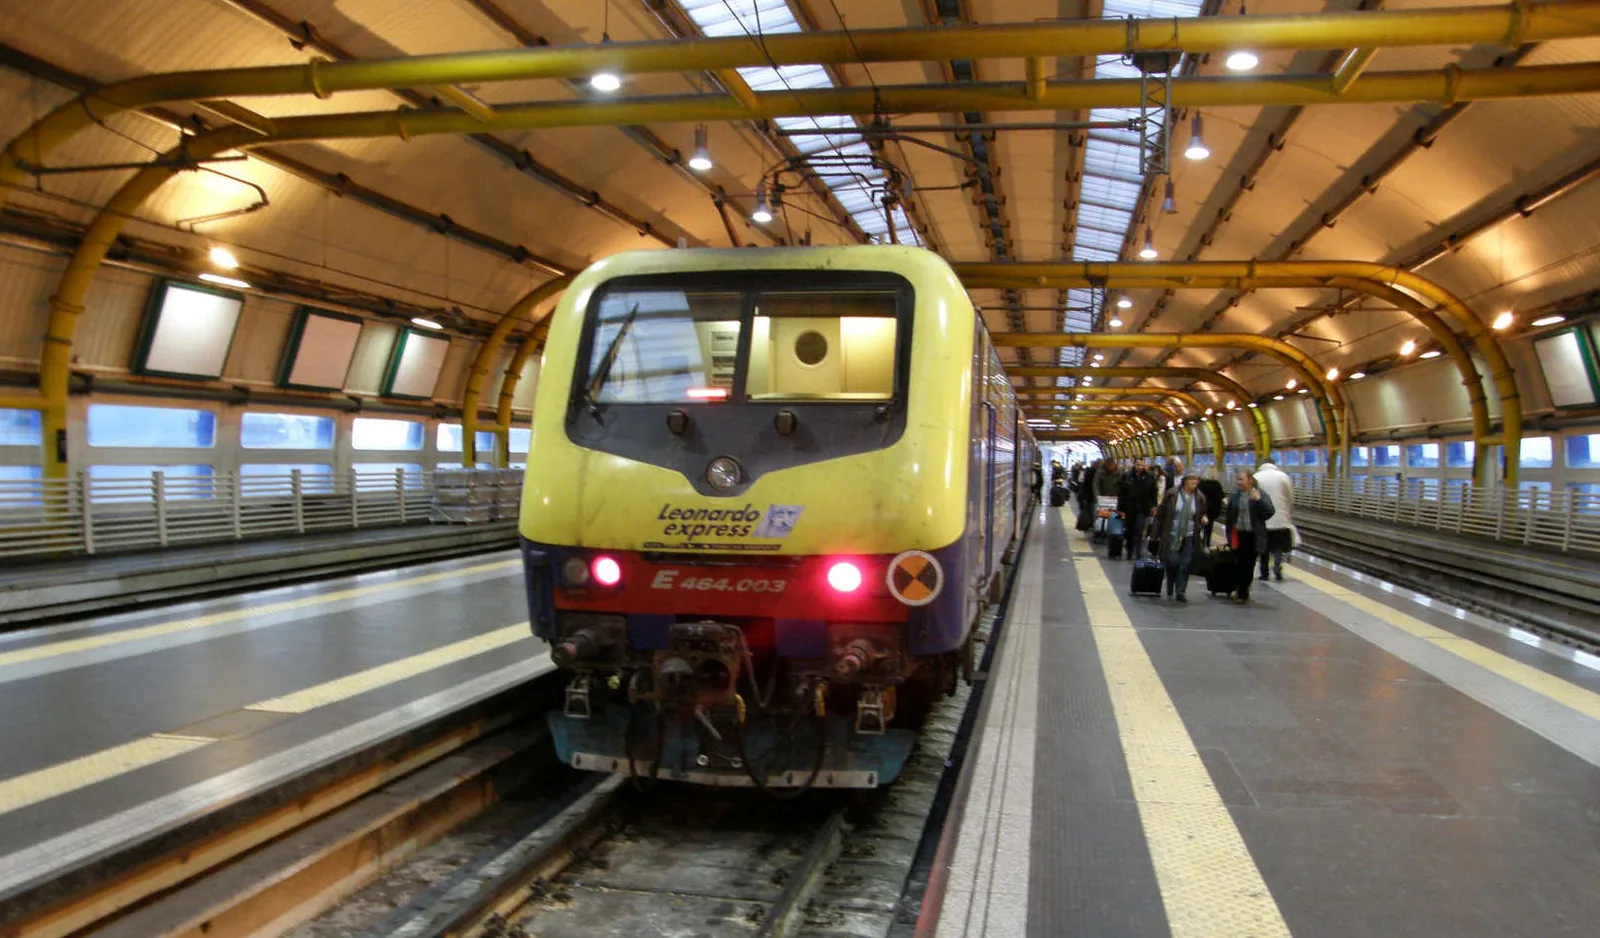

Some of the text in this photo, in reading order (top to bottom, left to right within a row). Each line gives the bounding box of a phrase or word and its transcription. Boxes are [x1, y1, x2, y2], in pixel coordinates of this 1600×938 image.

[657, 503, 761, 522] Leonardo
[663, 522, 752, 541] express
[650, 569, 787, 593] E 464.003
